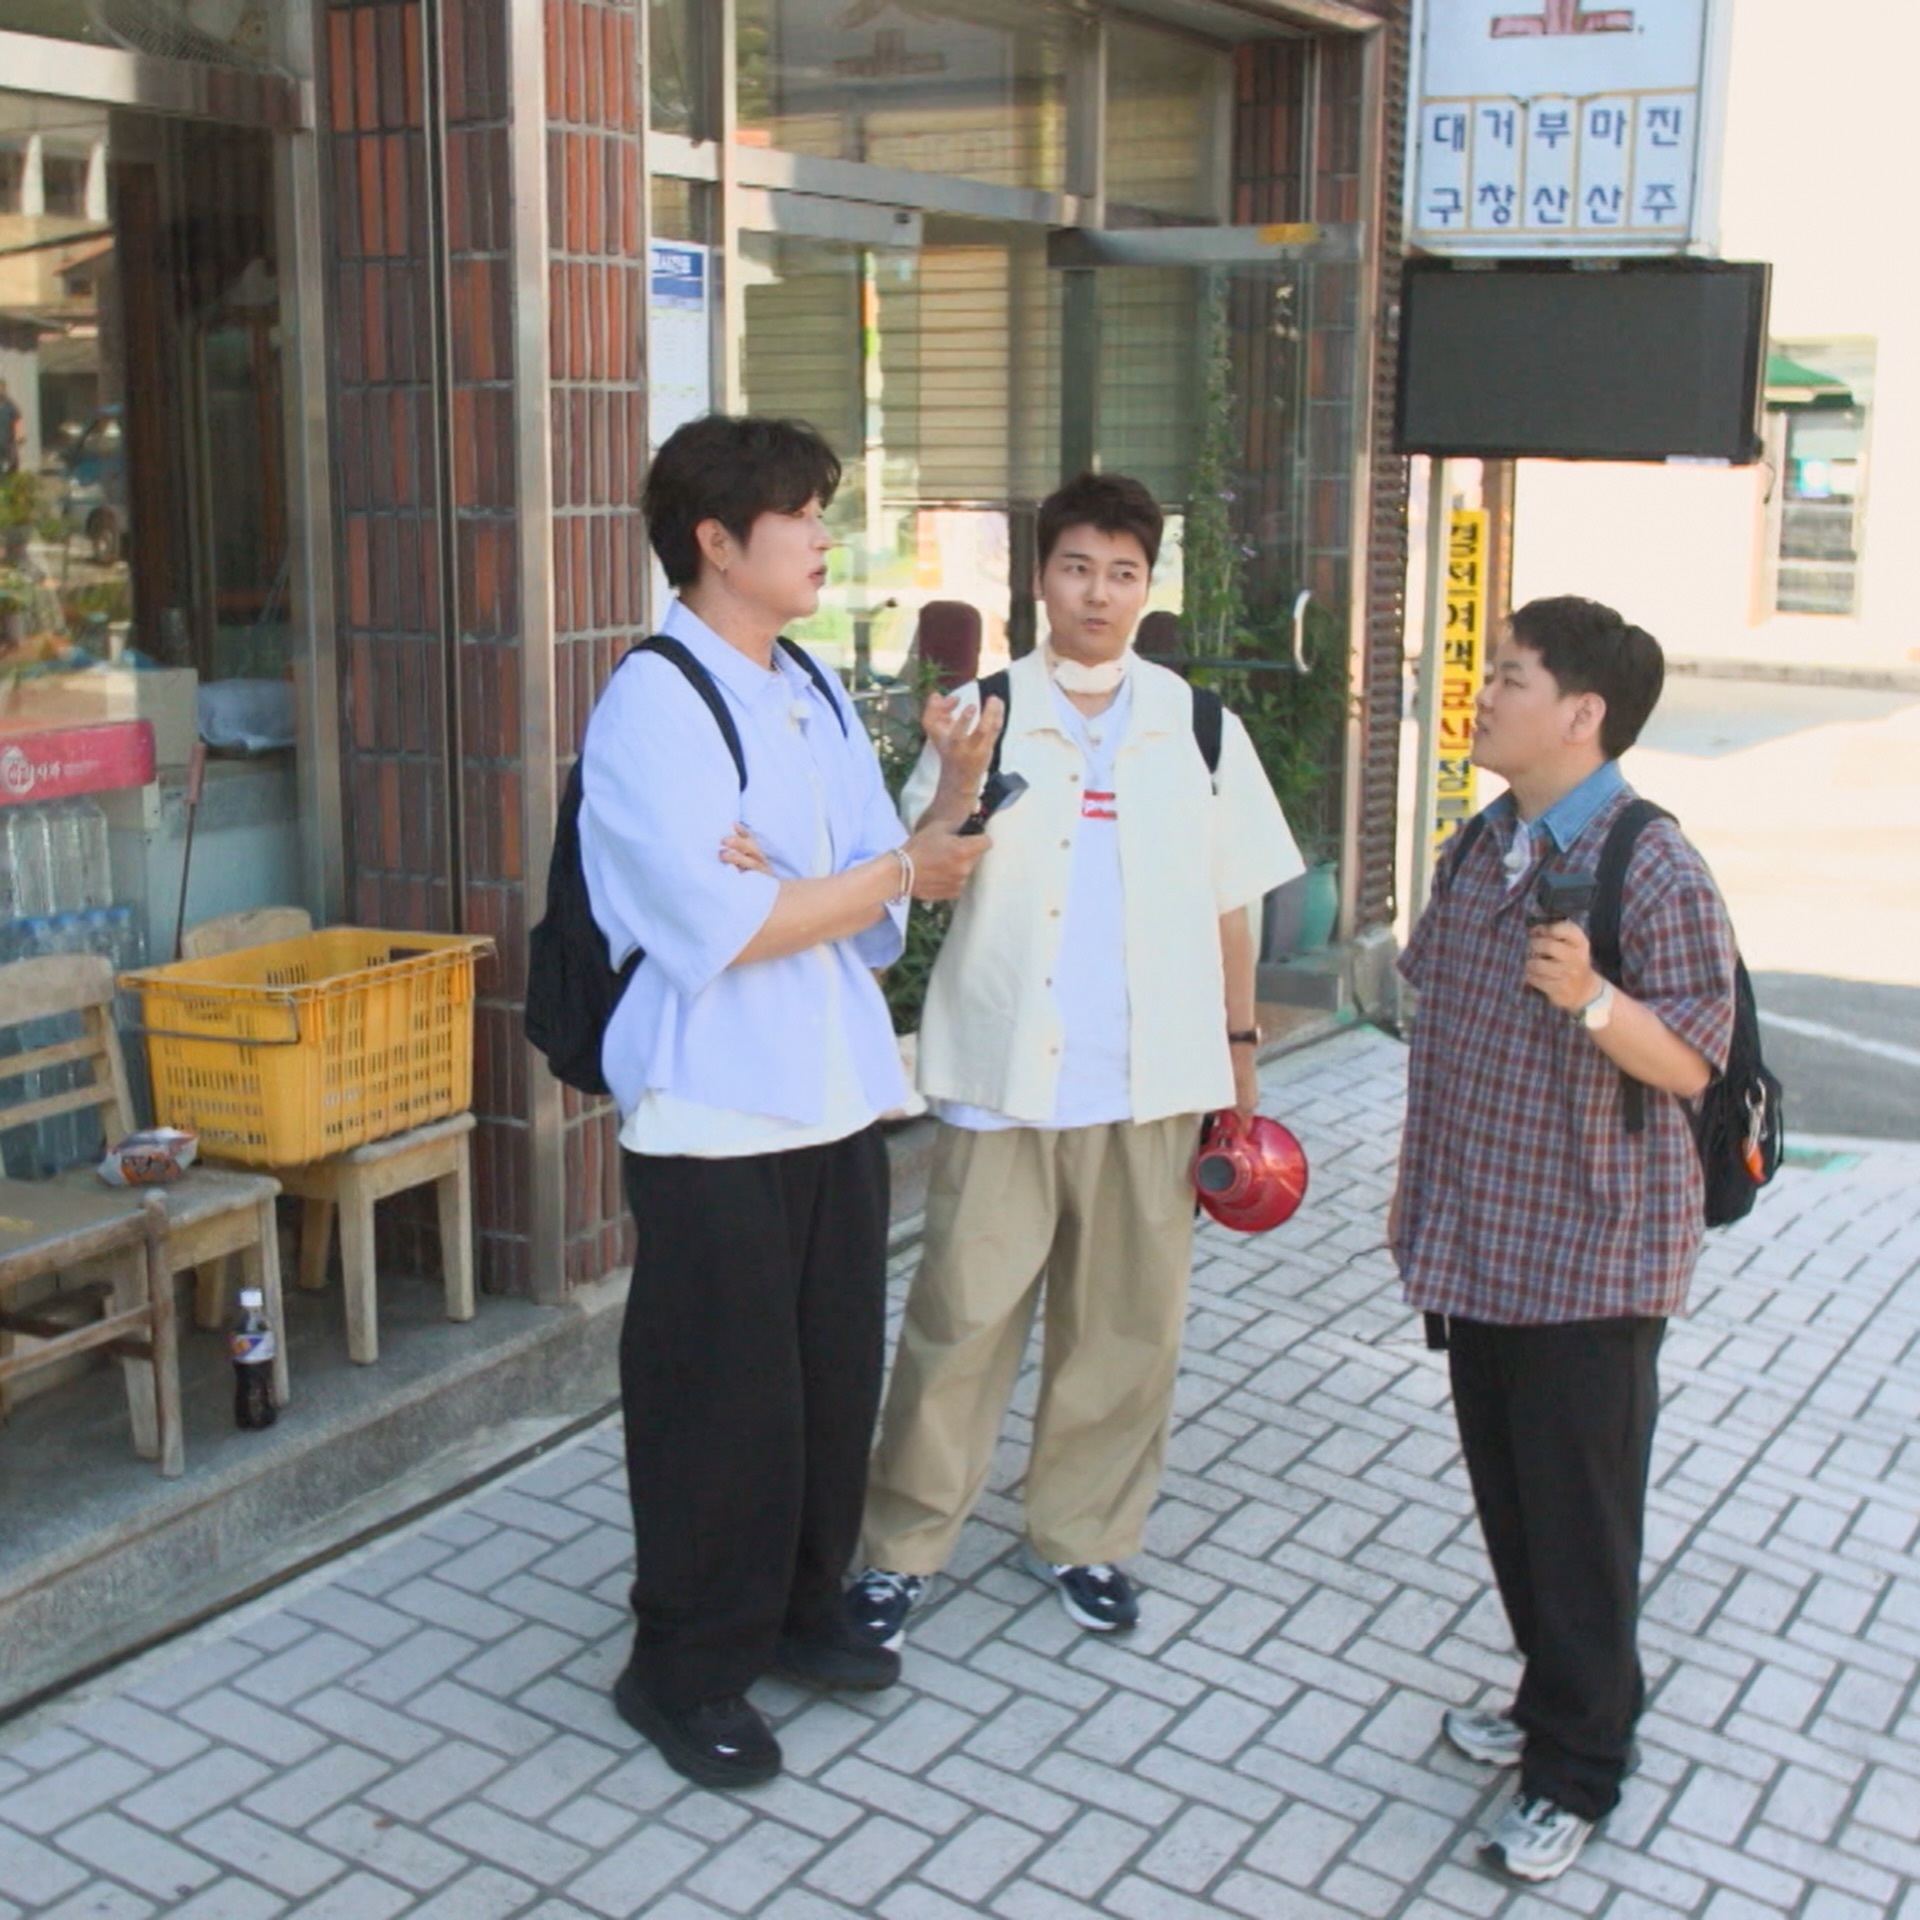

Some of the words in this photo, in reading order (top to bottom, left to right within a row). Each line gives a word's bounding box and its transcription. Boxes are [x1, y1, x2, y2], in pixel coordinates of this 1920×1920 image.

[1429, 113, 1466, 225] 대구
[1478, 109, 1516, 225] 거창
[1533, 110, 1570, 224] 부산
[1586, 109, 1627, 224] 마산
[1642, 106, 1682, 223] 진주
